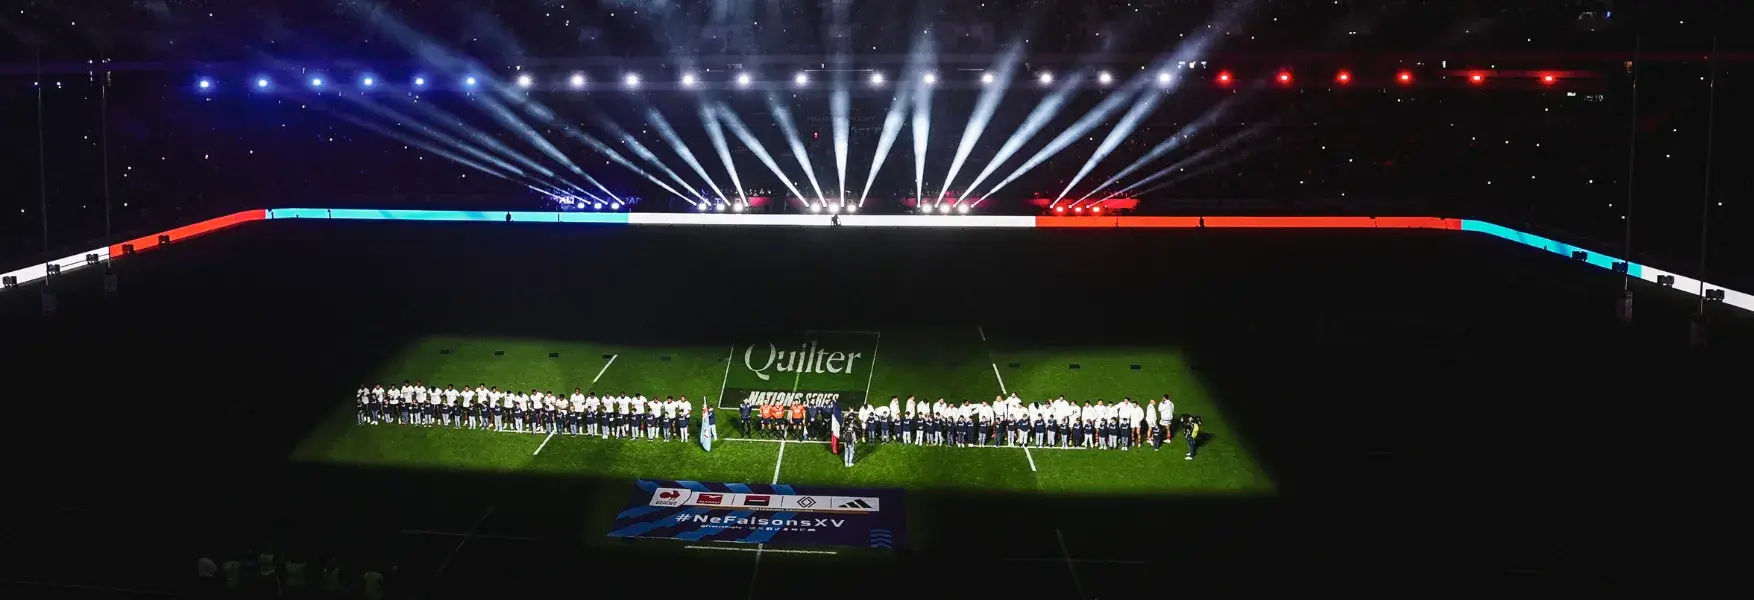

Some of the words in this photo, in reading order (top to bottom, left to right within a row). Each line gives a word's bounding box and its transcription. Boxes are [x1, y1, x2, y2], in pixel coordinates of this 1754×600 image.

[744, 340, 861, 381] Quilter
[748, 391, 803, 407] NATIONS
[803, 393, 840, 408] SERIES
[675, 513, 845, 528] #NeFaisonsXV
